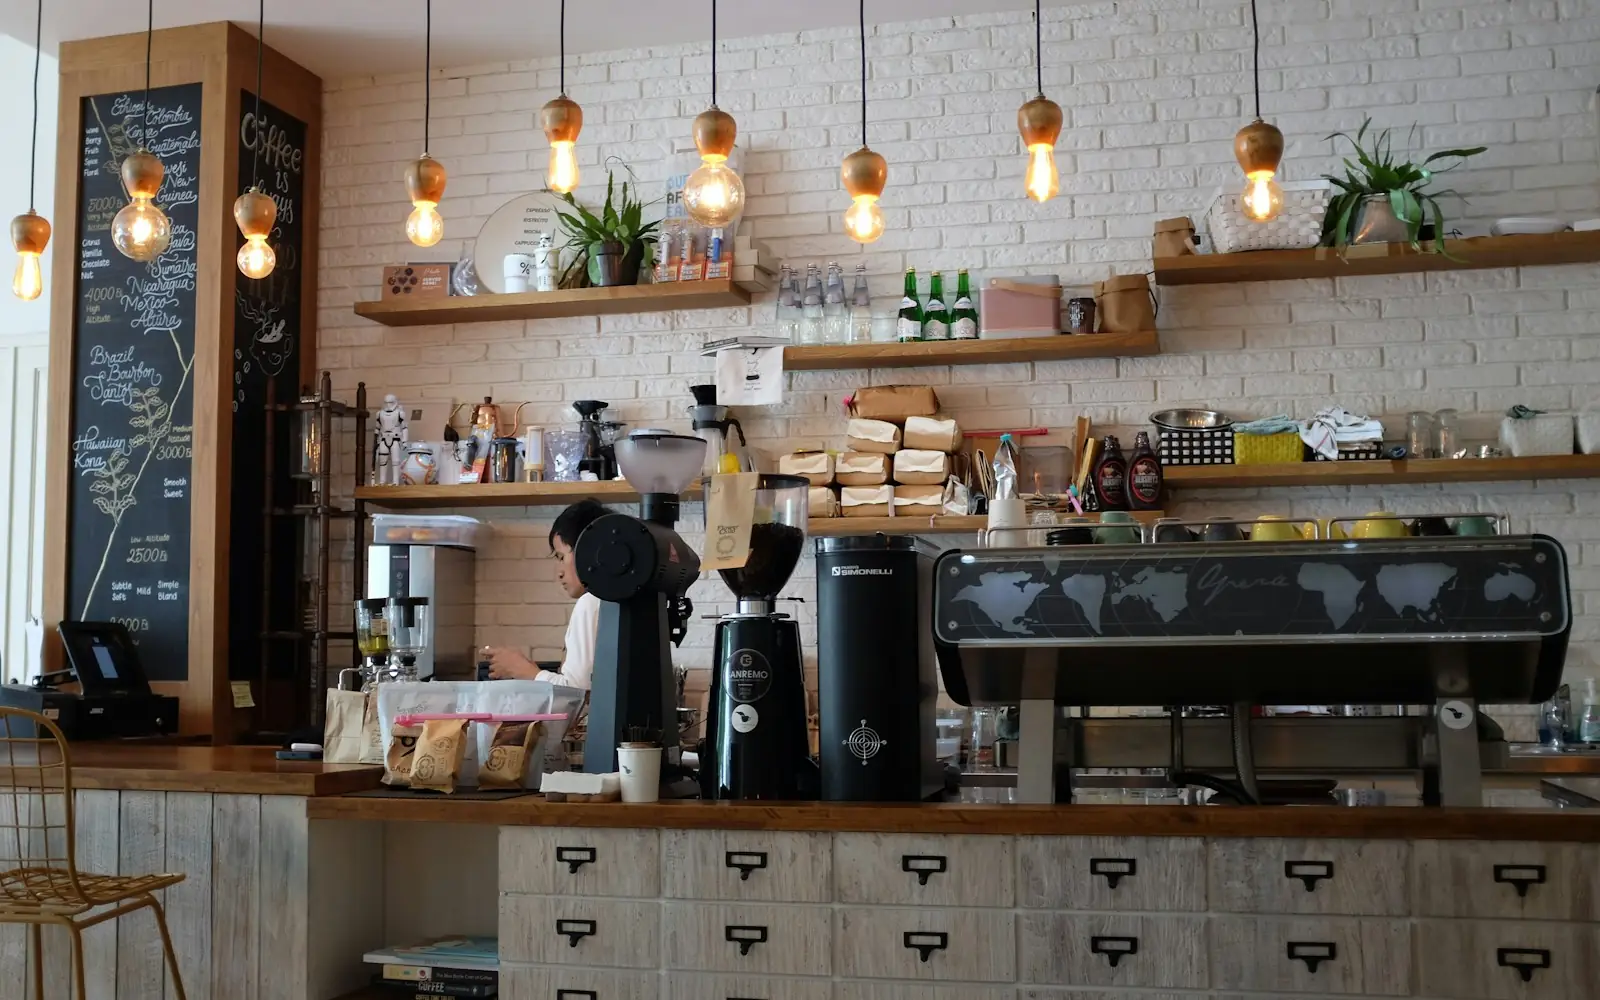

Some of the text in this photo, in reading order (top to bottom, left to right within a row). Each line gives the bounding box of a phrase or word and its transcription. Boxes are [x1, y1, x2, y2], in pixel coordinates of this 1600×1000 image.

[146, 104, 193, 132] Colombia
[146, 130, 201, 157] Guatemala
[241, 112, 302, 172] Coffee
[165, 174, 196, 189] New
[156, 186, 197, 210] Guinea
[160, 231, 195, 254] Java
[81, 259, 110, 269] Chocolate
[81, 271, 94, 279] Nut
[84, 286, 115, 303] 4000
[127, 276, 195, 298] Nicaragua
[121, 295, 179, 312] Mexico
[131, 310, 182, 335] Altura
[90, 345, 134, 367] Brazil
[107, 361, 162, 386] Bourbon
[83, 371, 133, 406] Santos
[72, 425, 132, 456] Hawaiian
[156, 445, 186, 460] 3000
[74, 452, 106, 476] Kona
[163, 477, 187, 487] Smooth
[163, 489, 184, 498] Sweet
[126, 547, 159, 563] 2500
[841, 568, 893, 576] SIMONELLI
[111, 580, 179, 595] Subtle Mild Simple
[111, 591, 178, 602] Soft Bland
[728, 670, 768, 680] ANREMO
